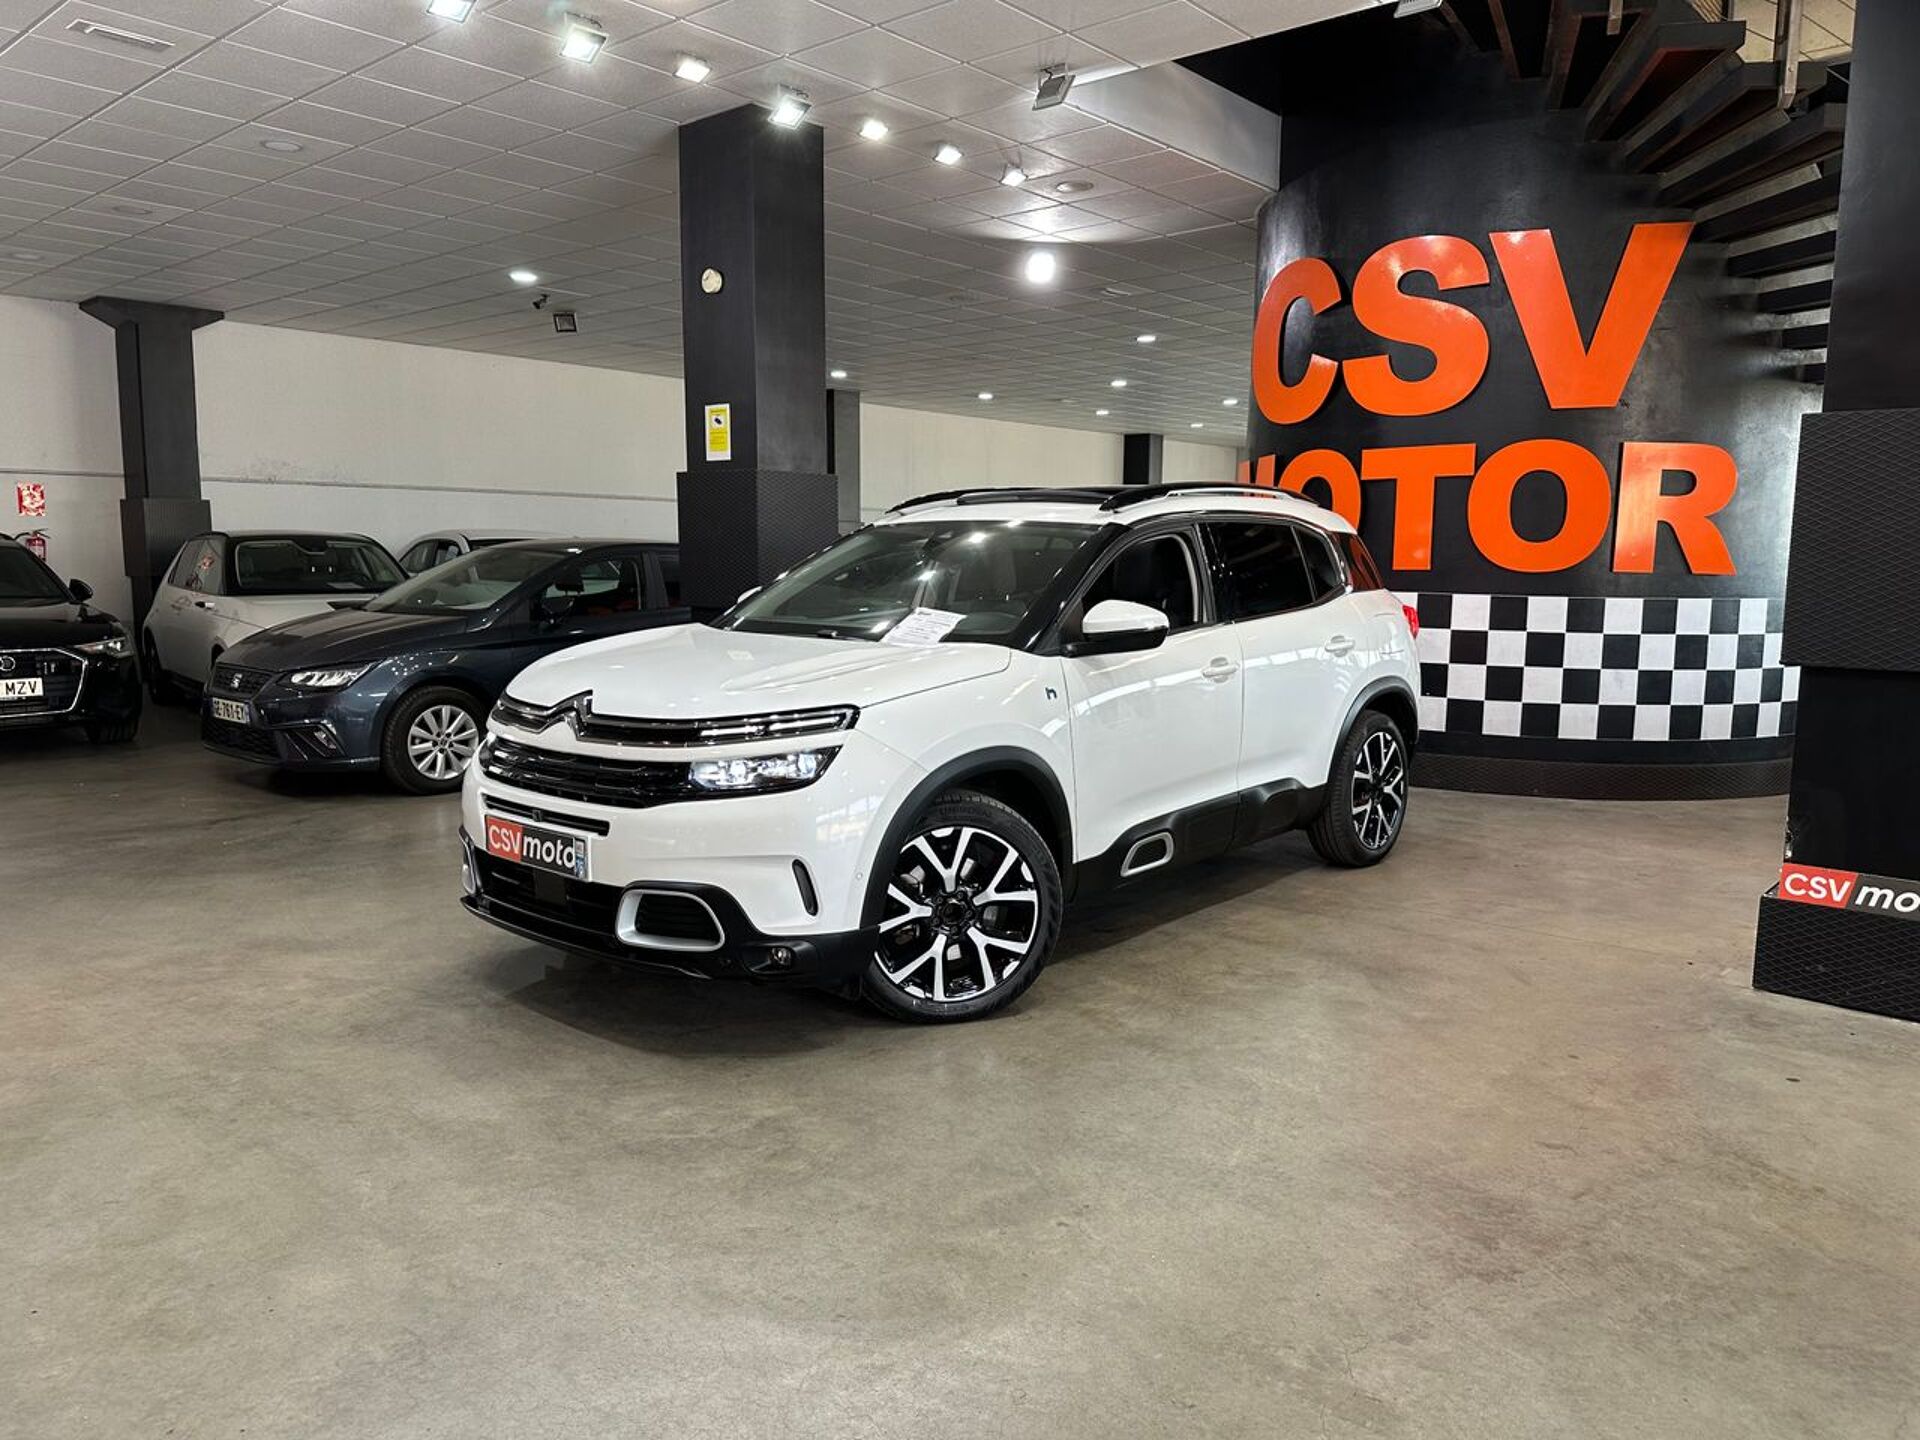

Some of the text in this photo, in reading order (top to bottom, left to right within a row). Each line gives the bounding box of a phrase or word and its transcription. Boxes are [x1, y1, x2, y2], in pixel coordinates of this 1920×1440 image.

[1252, 221, 1695, 425] CSV
[1238, 438, 1738, 576] OTOR
[5, 681, 37, 696] MZV
